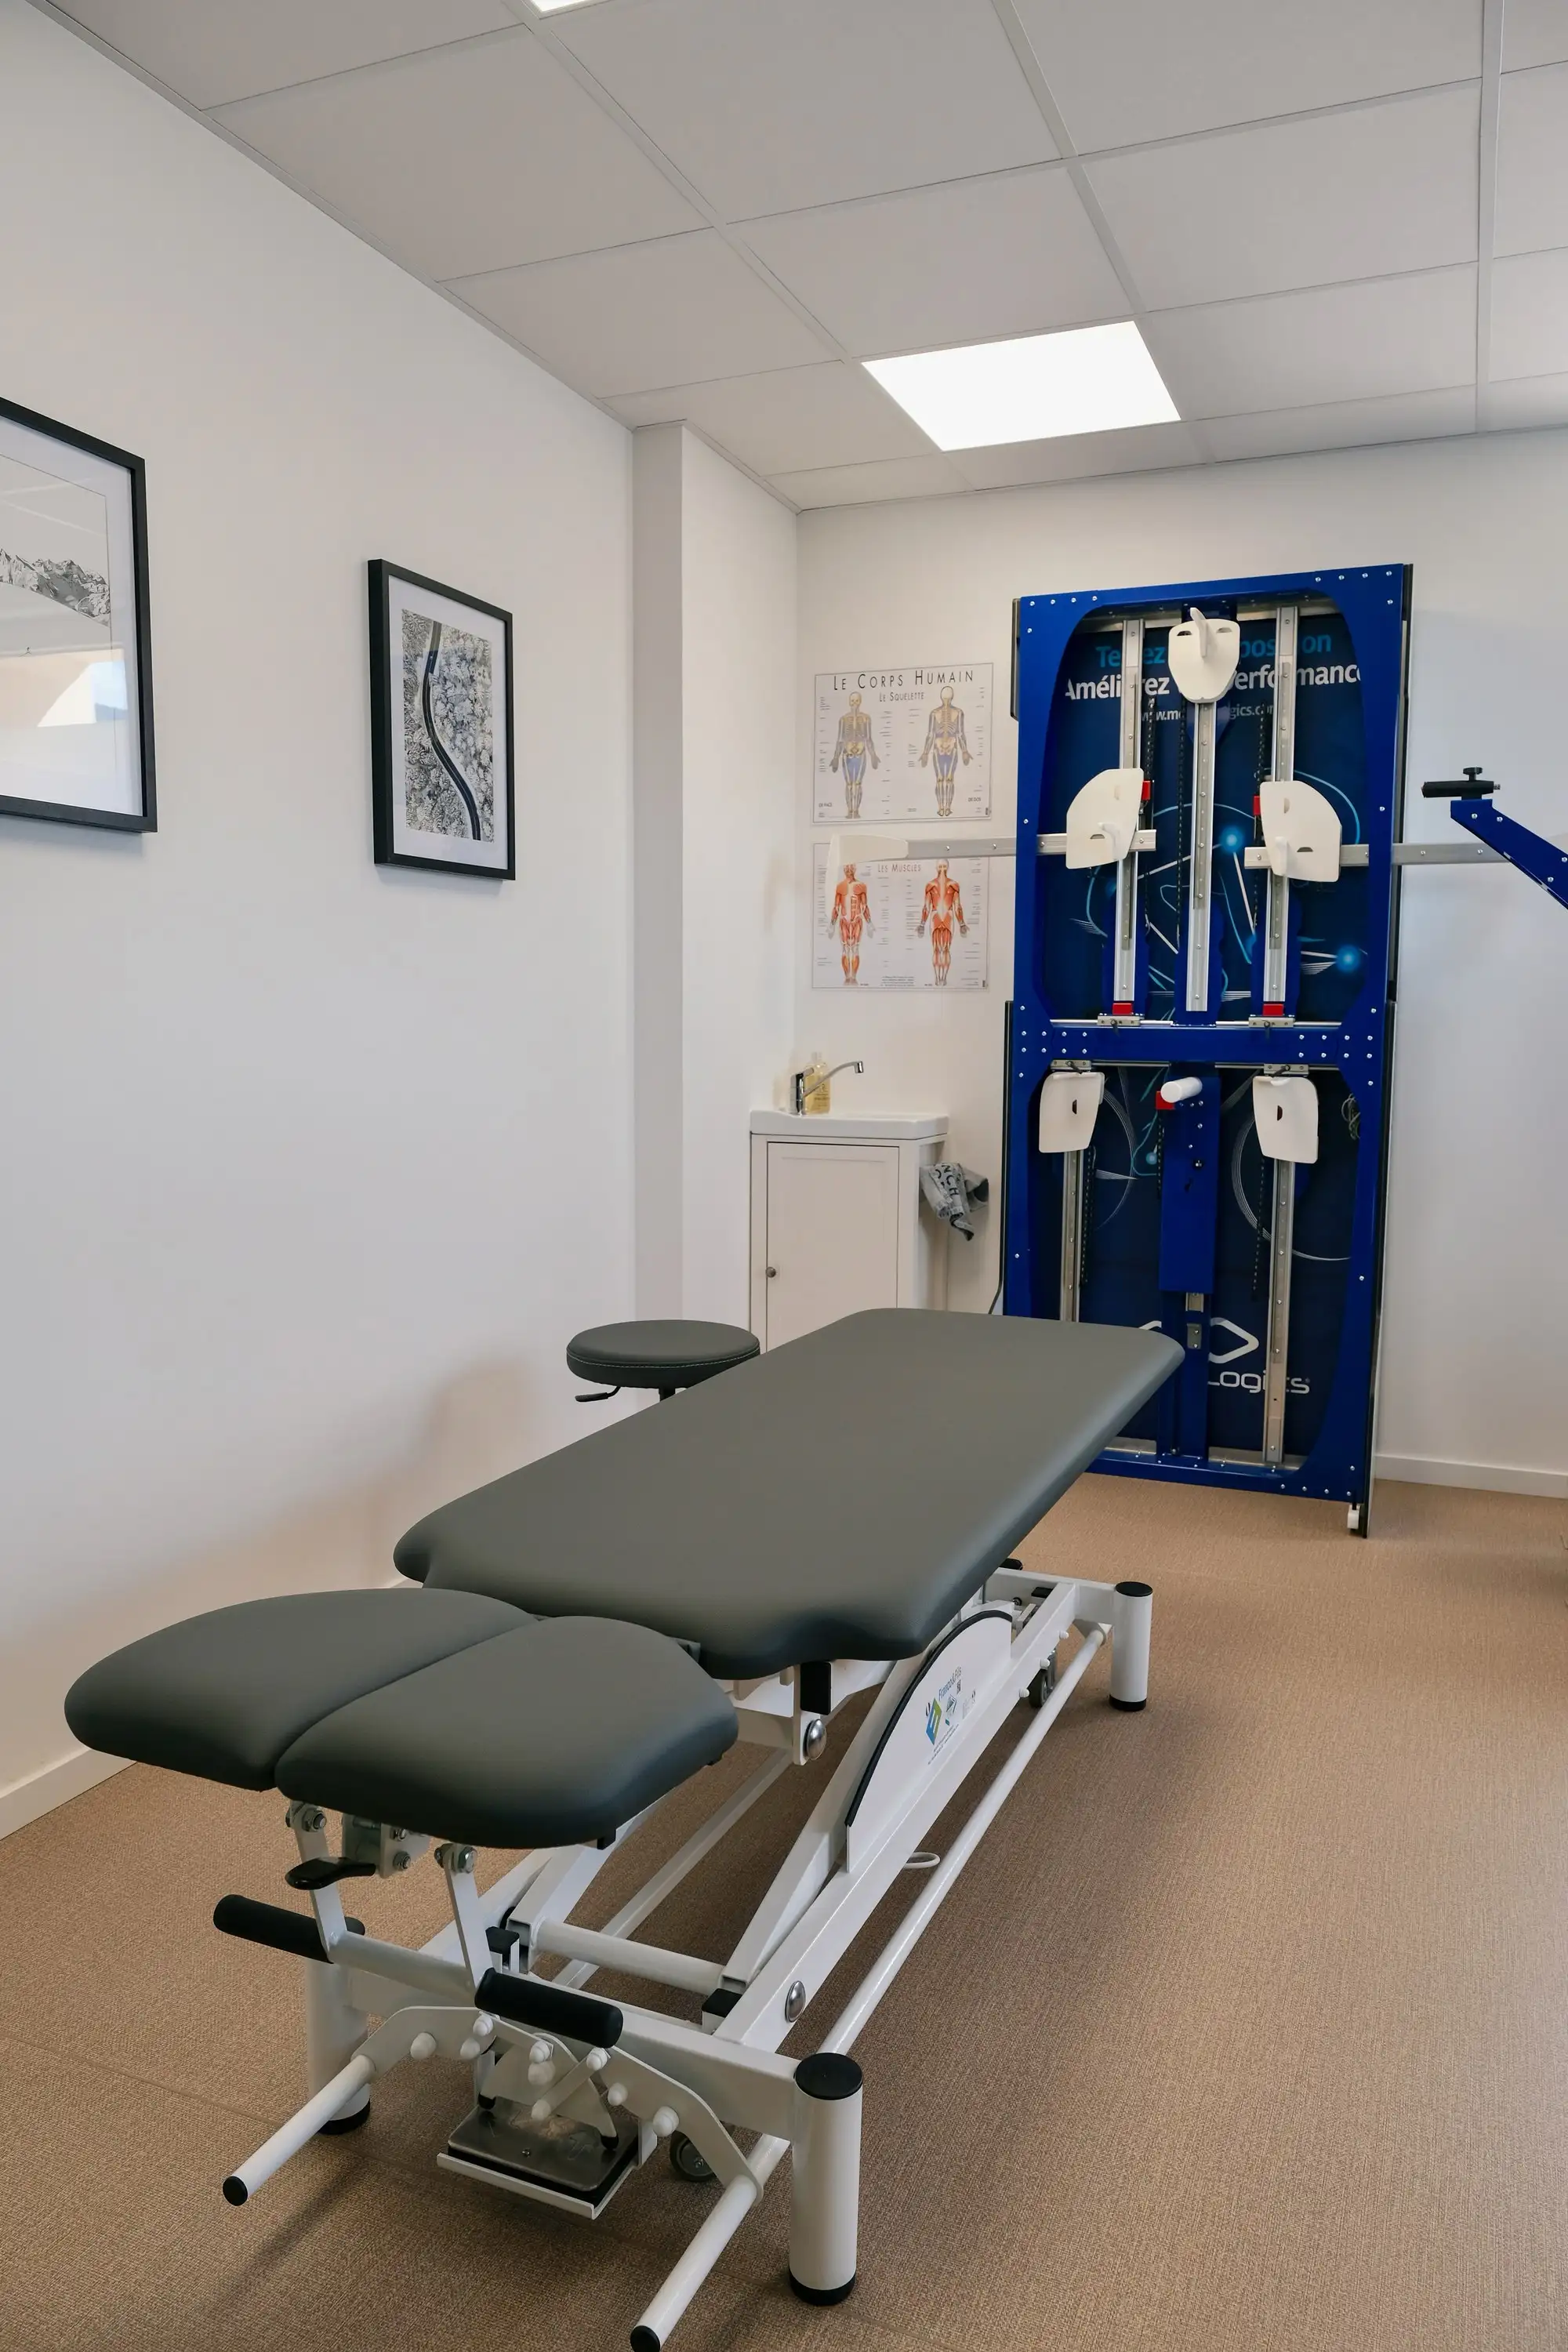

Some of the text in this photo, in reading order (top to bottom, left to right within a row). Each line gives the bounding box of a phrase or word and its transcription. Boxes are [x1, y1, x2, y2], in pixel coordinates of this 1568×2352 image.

[833, 670, 973, 691] LE CORPS HUMAIN
[1065, 674, 1171, 700] Améliez
[879, 691, 924, 702] LE SQUELETTE
[878, 864, 887, 873] LES
[891, 863, 921, 872] MUSCLES
